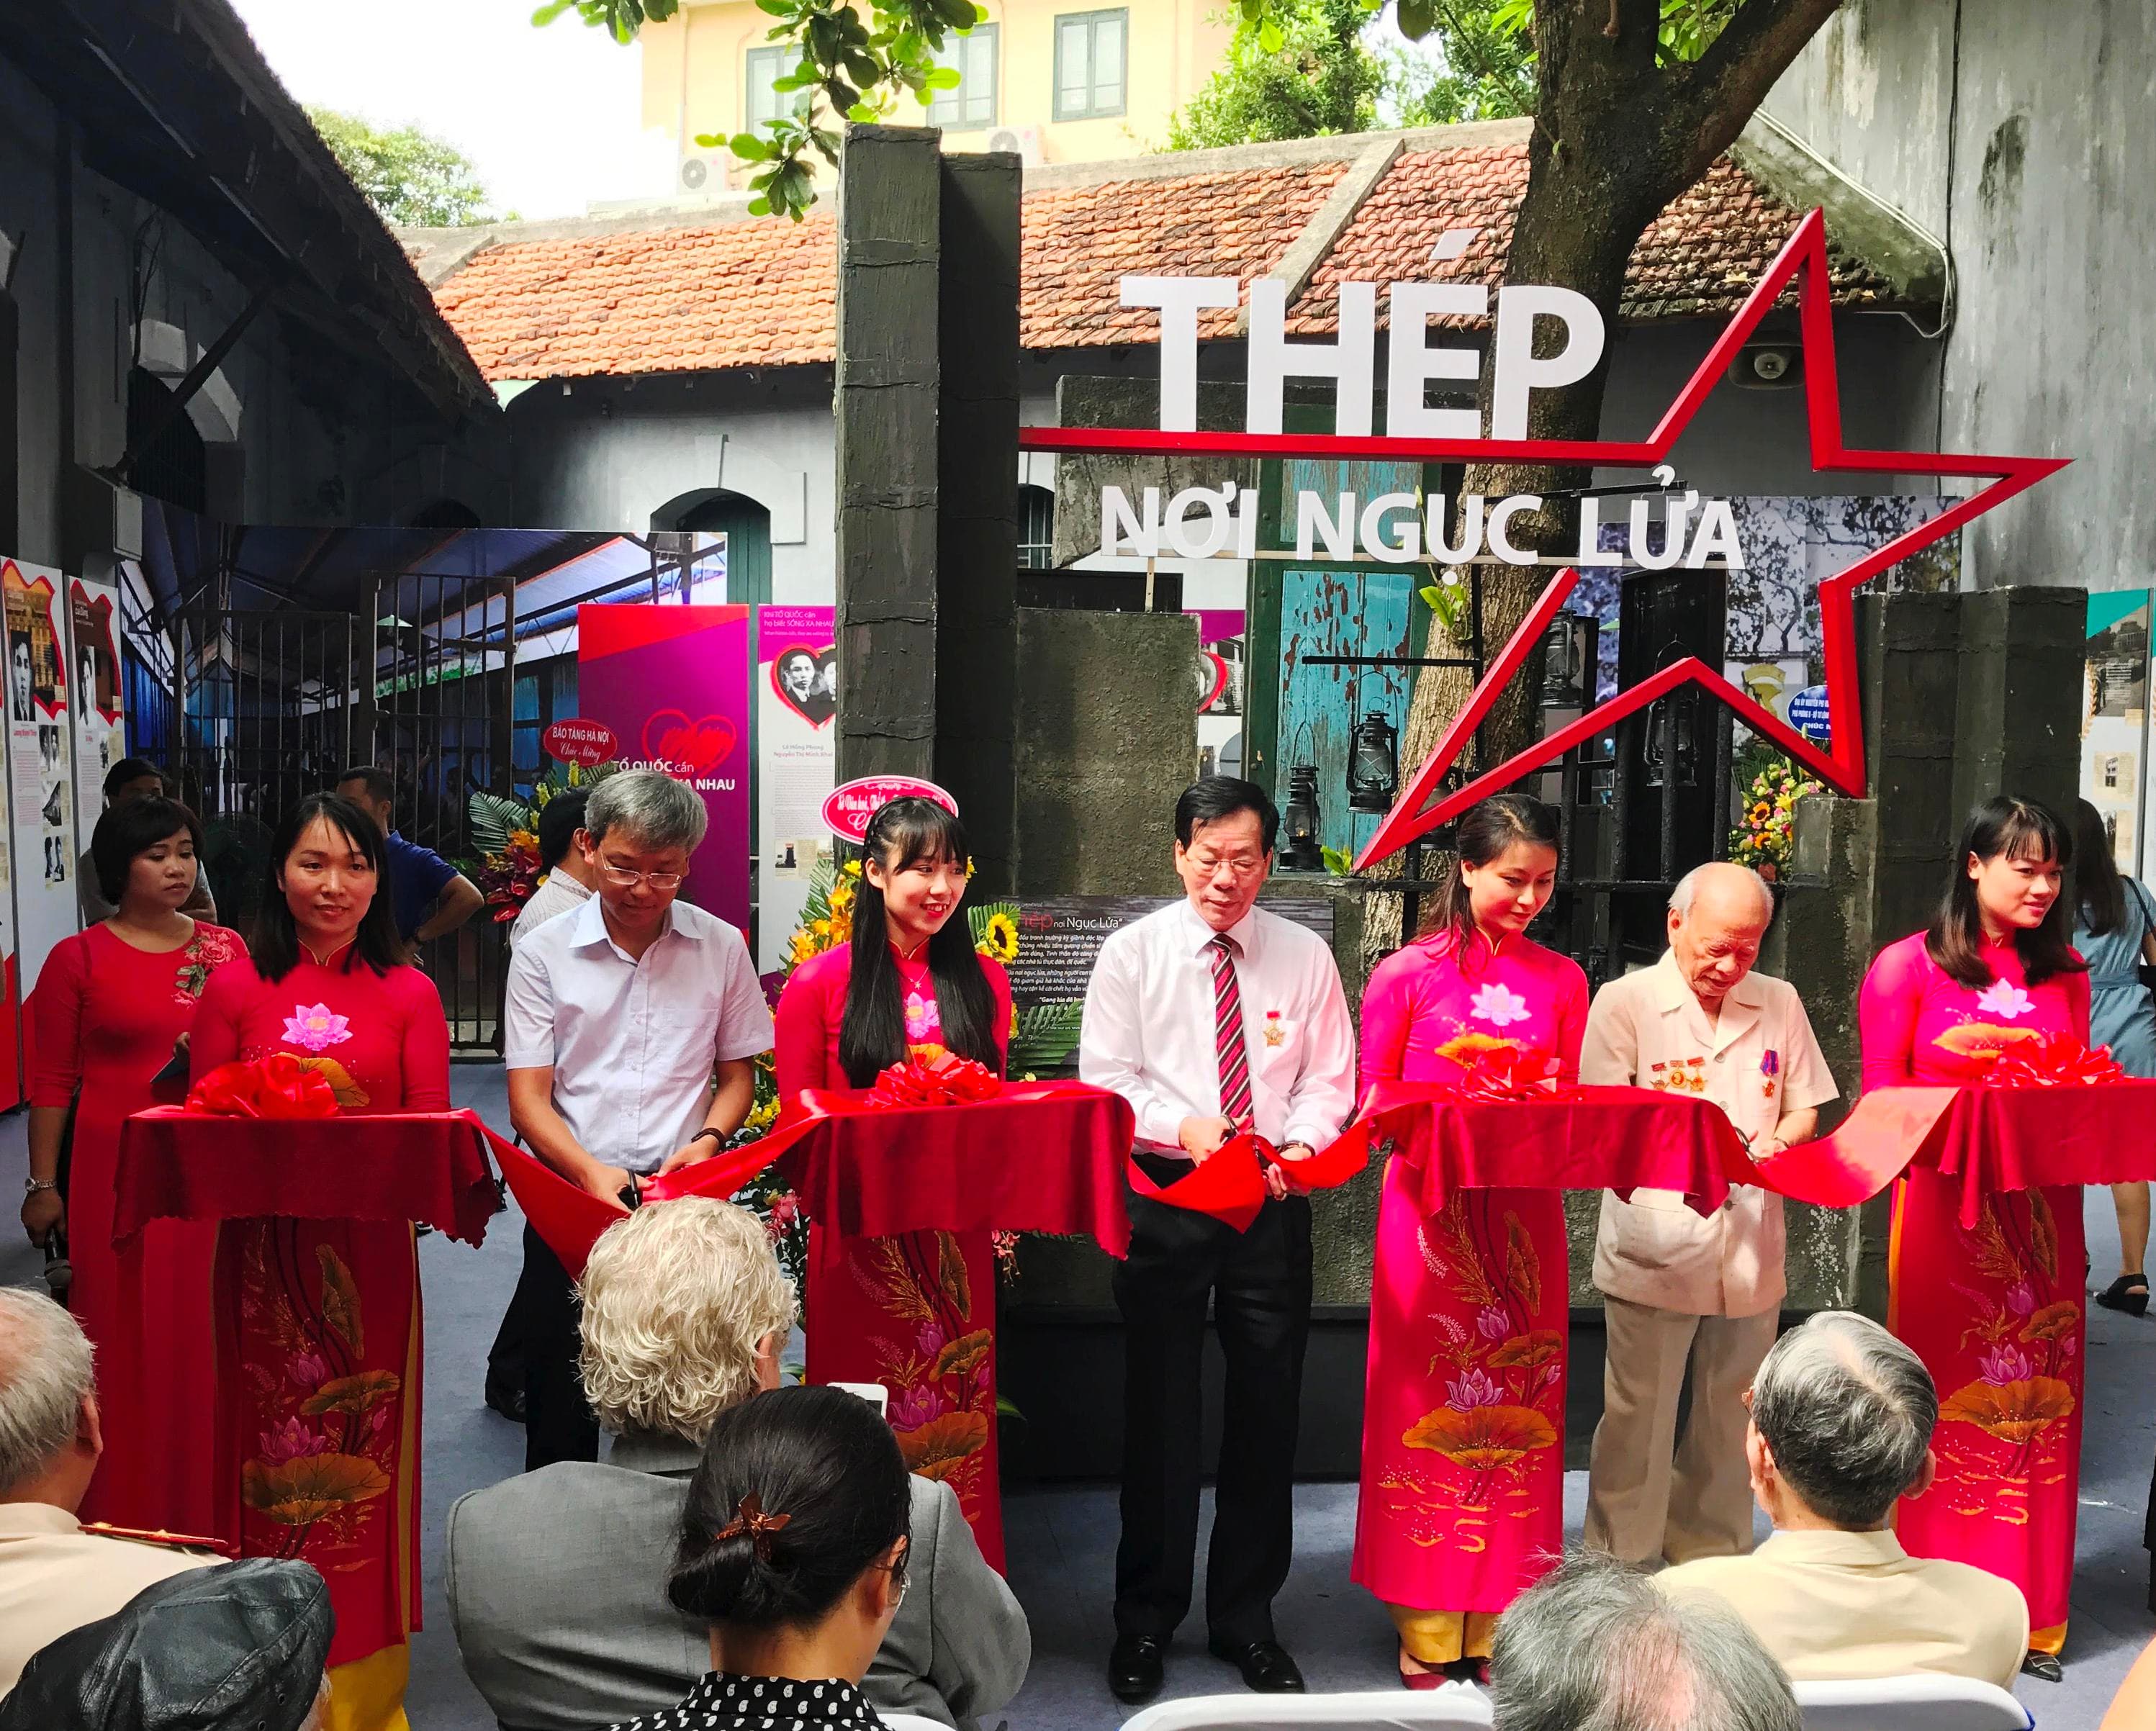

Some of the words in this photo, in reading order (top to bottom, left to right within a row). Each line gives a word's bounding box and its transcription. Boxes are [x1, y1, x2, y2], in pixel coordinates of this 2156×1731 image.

[1120, 228, 1606, 440] THÉP
[1101, 480, 1258, 559] NƠI
[1296, 490, 1543, 586] NGỤC
[1580, 464, 1746, 570] LỬA
[553, 725, 567, 738] BẢO
[567, 726, 586, 741] TÀNG
[587, 728, 596, 742] HÀ
[597, 731, 610, 745] NỘI
[633, 758, 673, 772] QUỐC
[696, 779, 735, 790] NHAU
[1067, 917, 1096, 931] Ngục
